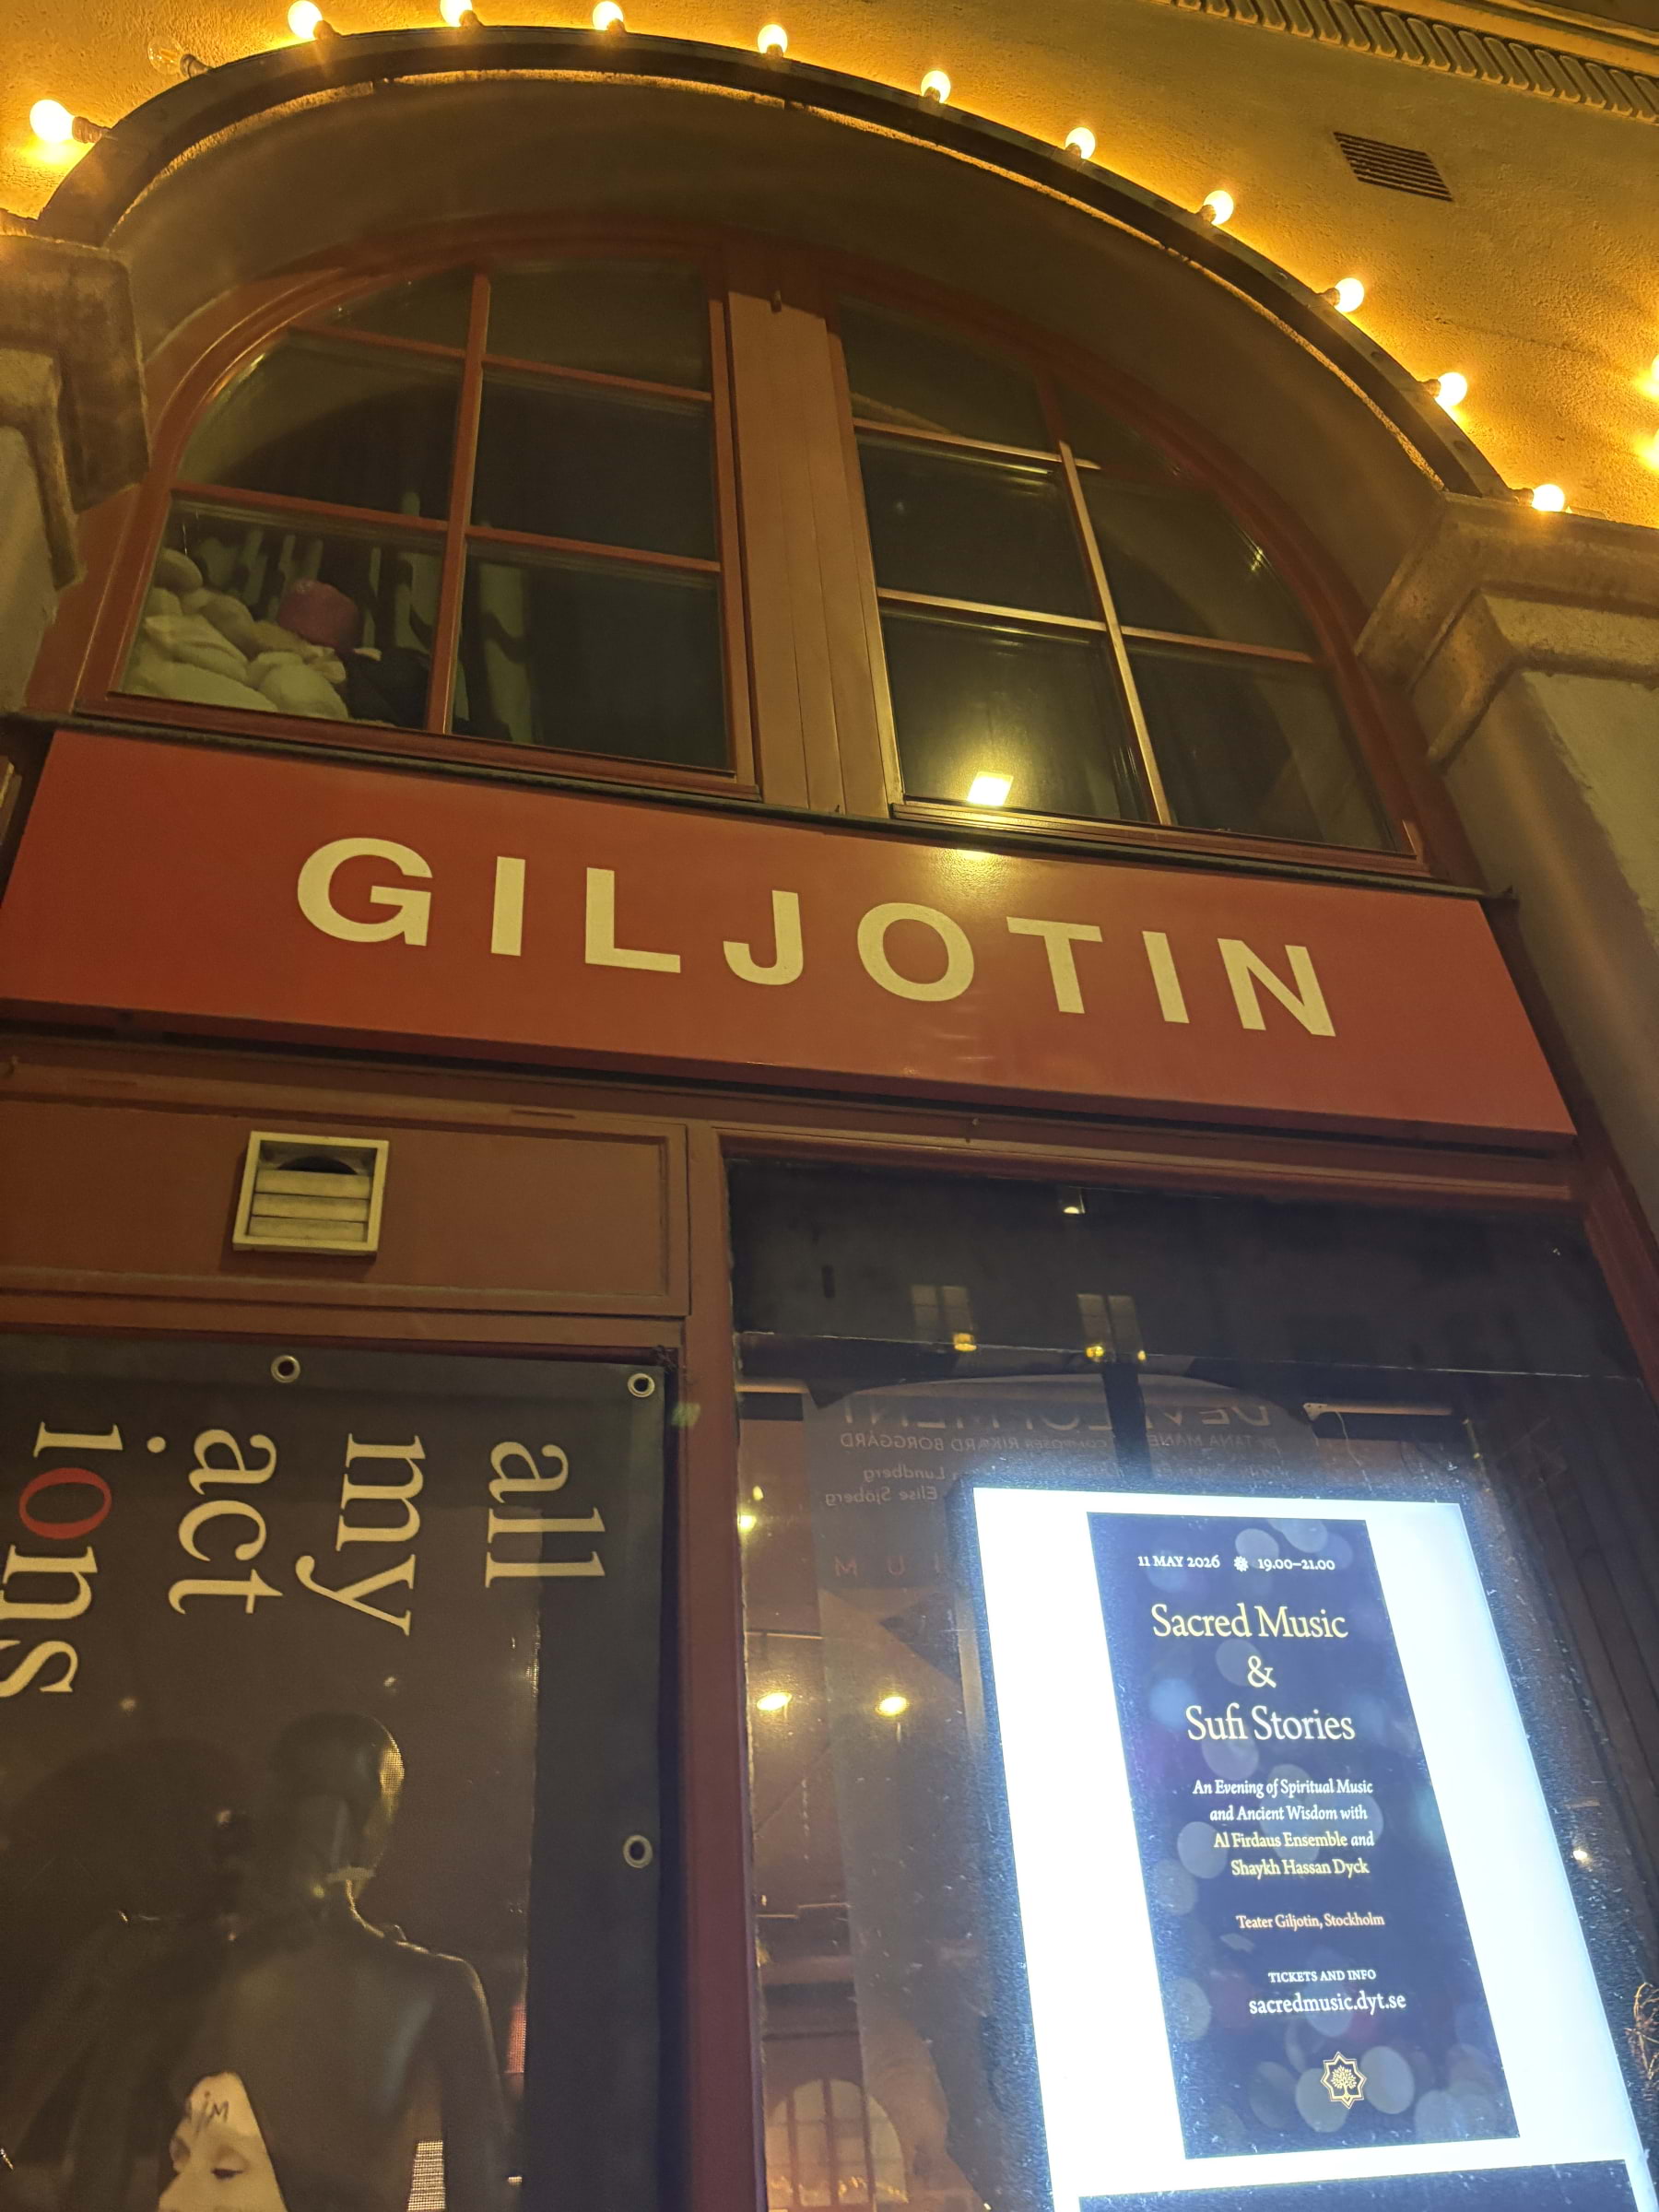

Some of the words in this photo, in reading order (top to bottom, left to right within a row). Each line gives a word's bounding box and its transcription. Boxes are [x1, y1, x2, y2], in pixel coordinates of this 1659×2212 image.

[297, 836, 1336, 1038] GILJOTIN
[168, 1428, 283, 1615] act
[487, 1441, 606, 1588] all
[295, 1433, 426, 1636] my
[1138, 1556, 1150, 1567] 11
[1152, 1556, 1183, 1568] MAY
[1187, 1555, 1220, 1568] 2026
[1151, 1603, 1253, 1638] Sacred
[1254, 1606, 1348, 1638] Music
[1247, 1655, 1277, 1688] &
[1185, 1702, 1248, 1740] Sufi
[1252, 1705, 1355, 1740] Stories
[1193, 1780, 1212, 1794] An
[1215, 1779, 1265, 1799] Evening
[1266, 1778, 1279, 1799] of
[1280, 1778, 1334, 1798] Spiritual
[1335, 1779, 1373, 1794] Music
[1210, 1805, 1234, 1821] and
[1236, 1806, 1285, 1821] Ancient
[1286, 1805, 1337, 1820] Wisdom
[1340, 1805, 1368, 1819] with
[1214, 1831, 1230, 1848] Al
[1231, 1831, 1281, 1848] Firdaus
[1283, 1831, 1347, 1847] Ensemble
[1350, 1830, 1374, 1847] and
[1231, 1859, 1281, 1879] Shaykh
[1281, 1859, 1331, 1875] Hassan
[1332, 1858, 1370, 1878] Dyck
[1235, 1915, 1274, 1929] Teater
[1275, 1913, 1323, 1932] Giljotin,
[1324, 1912, 1385, 1927] Stockholm
[1267, 1971, 1318, 1983] TICKETS
[1320, 1970, 1346, 1982] AND
[1347, 1969, 1376, 1981] INFO
[1248, 1990, 1406, 2016] sacredmusic.dyt.se
